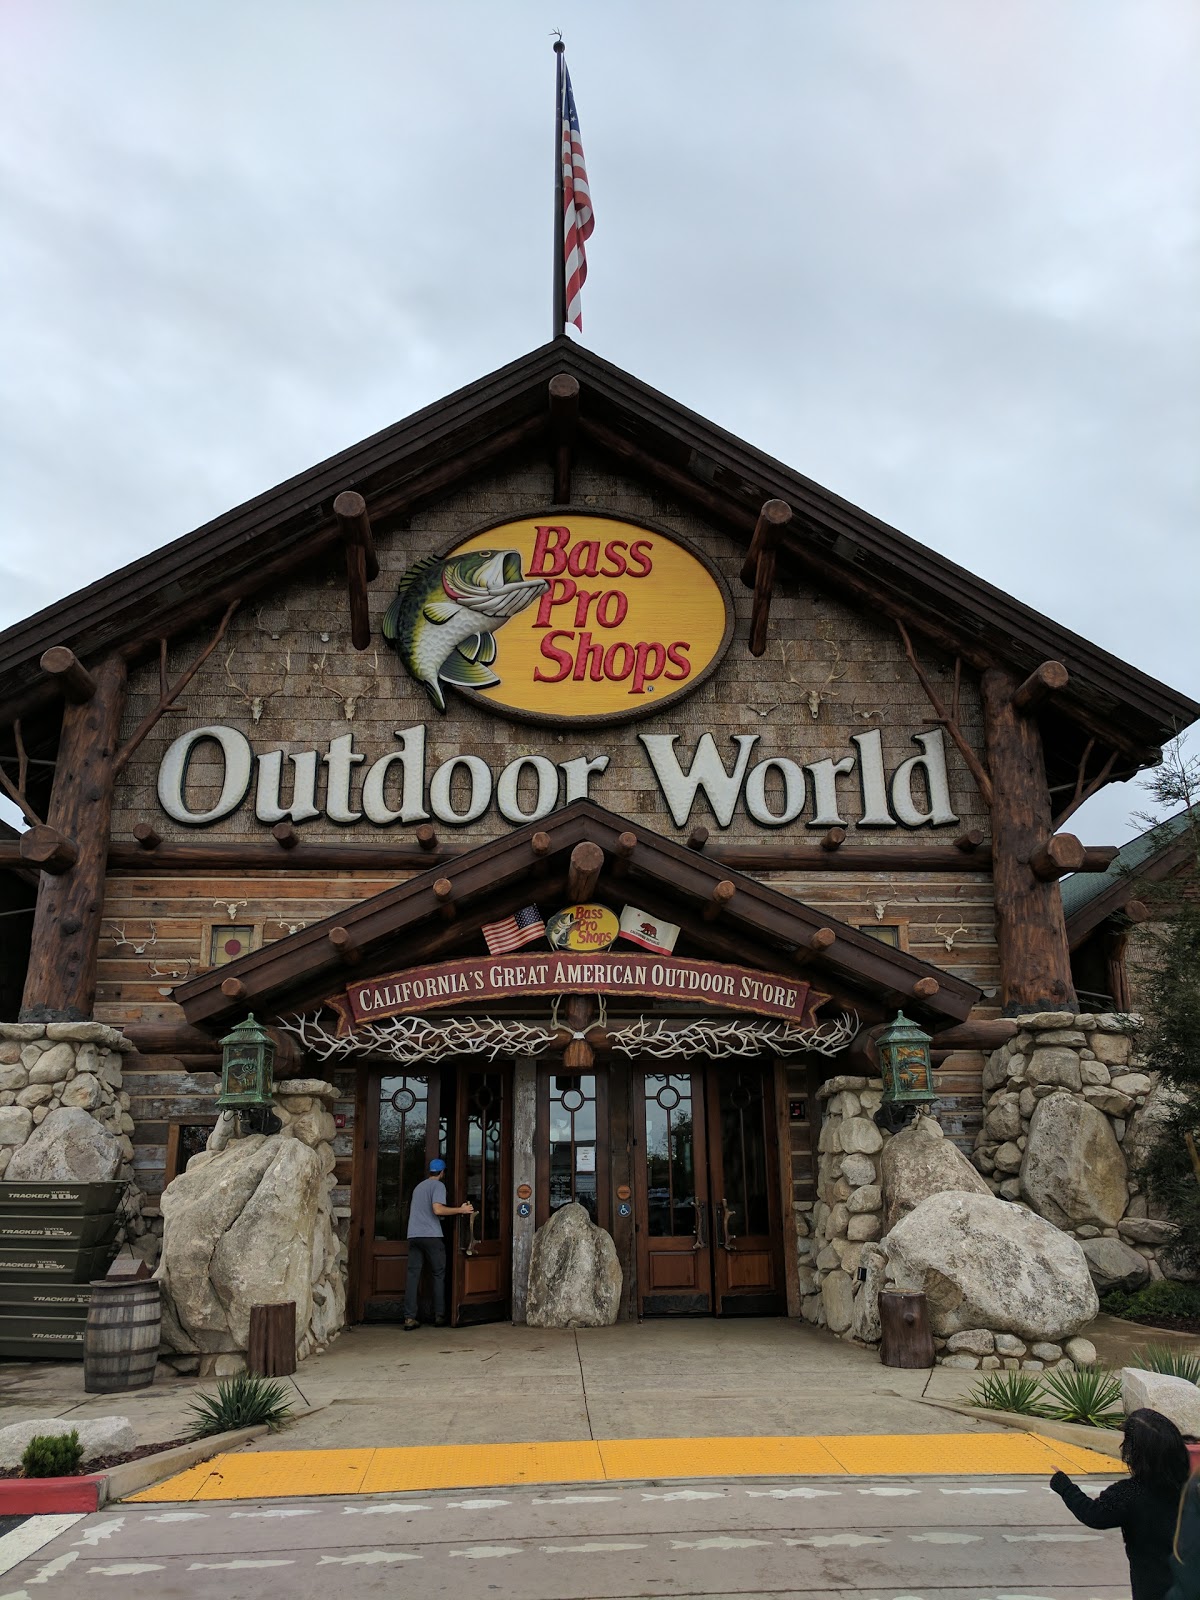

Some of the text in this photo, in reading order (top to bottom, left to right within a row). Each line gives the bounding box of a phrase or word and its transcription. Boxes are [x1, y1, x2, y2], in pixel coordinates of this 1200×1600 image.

[525, 526, 654, 578] Bass
[532, 579, 628, 628] Pro
[534, 630, 691, 694] Shops
[156, 723, 959, 831] Outdoor World
[575, 906, 603, 920] Bass
[577, 920, 598, 931] Pro
[577, 931, 612, 946] Shops
[359, 961, 798, 1012] CALIFORNIA'S GREAT AMERICAN OUTDOOR STORE
